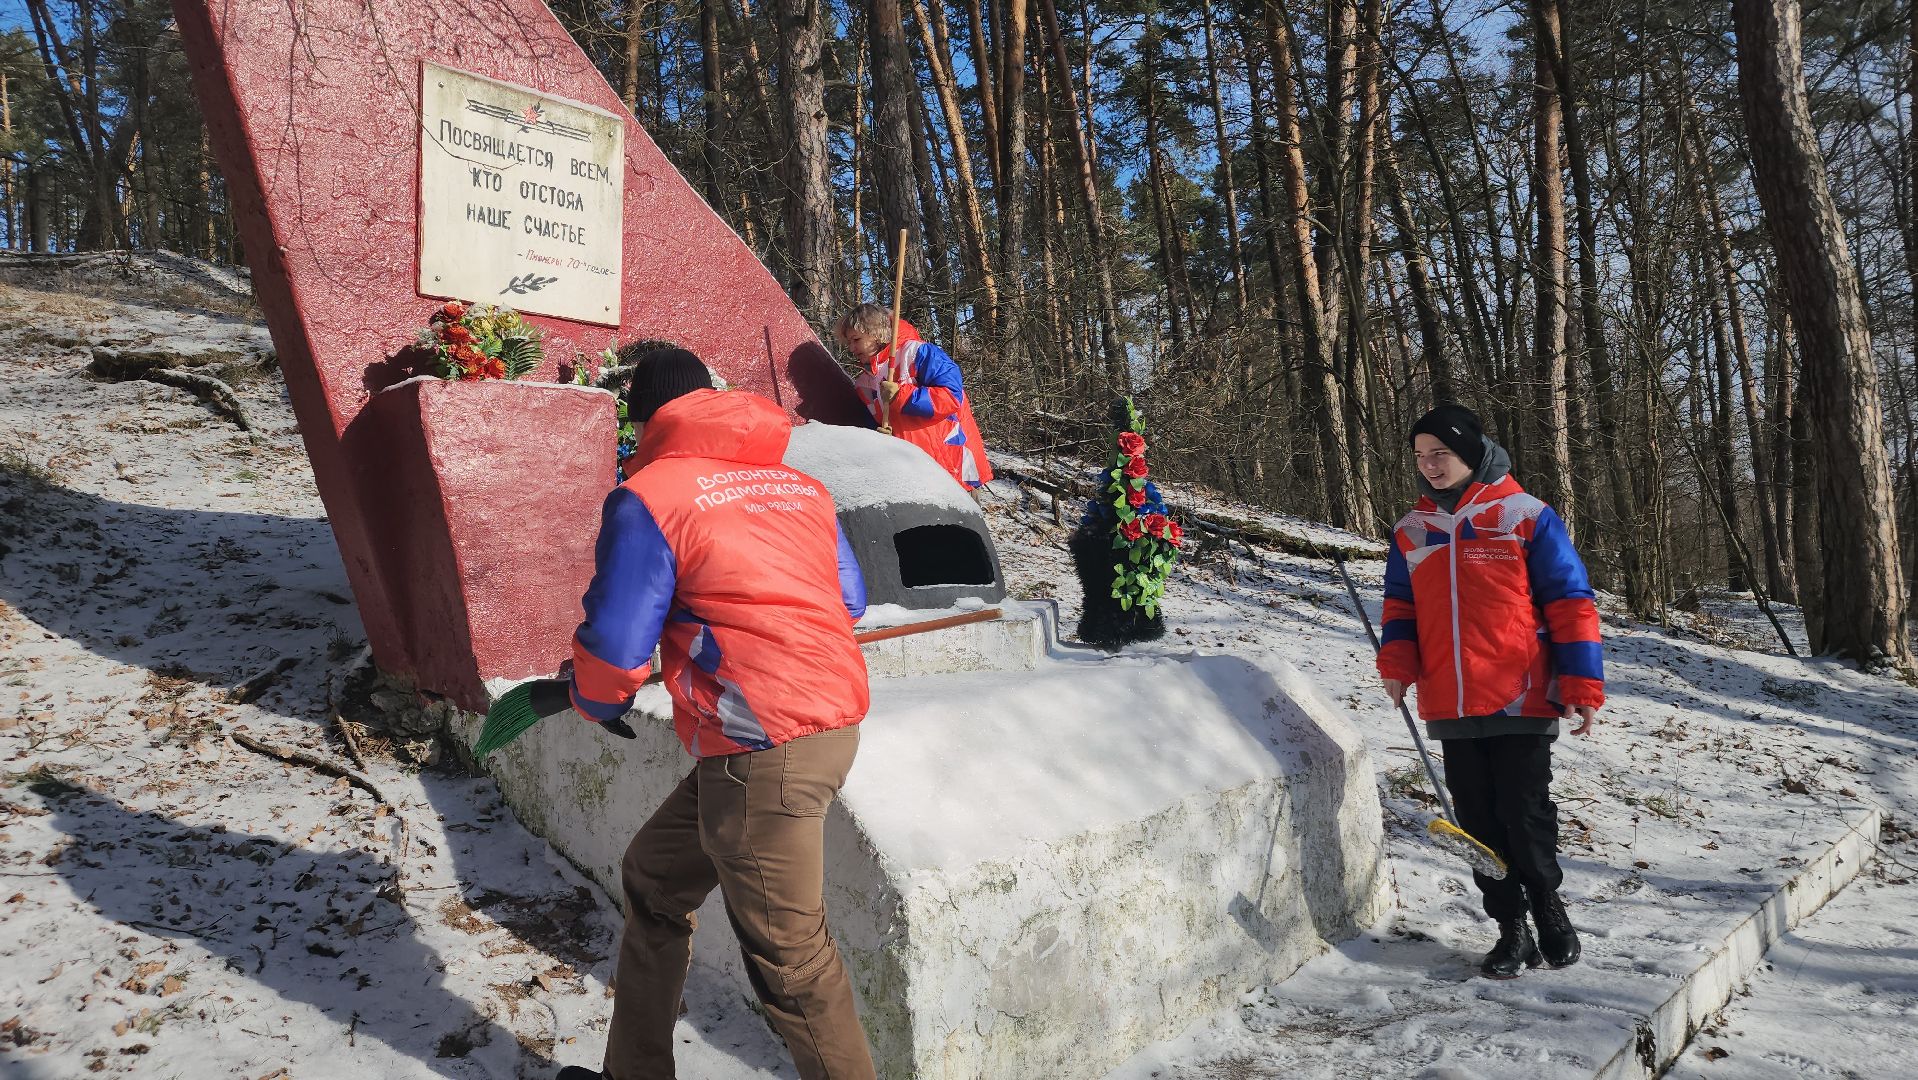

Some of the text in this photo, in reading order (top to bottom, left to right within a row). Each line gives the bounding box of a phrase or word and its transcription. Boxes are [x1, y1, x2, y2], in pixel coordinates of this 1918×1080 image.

[472, 167, 584, 212] КТО ОТСТОЯЛ
[466, 203, 586, 246] НАШЕ СЧАСТЬЕ
[696, 469, 801, 491] ВОЛОНТЕРЫ
[693, 482, 819, 512] ПОДМОСКОВЬЯ
[744, 501, 803, 514] МЫ РЯДОМ
